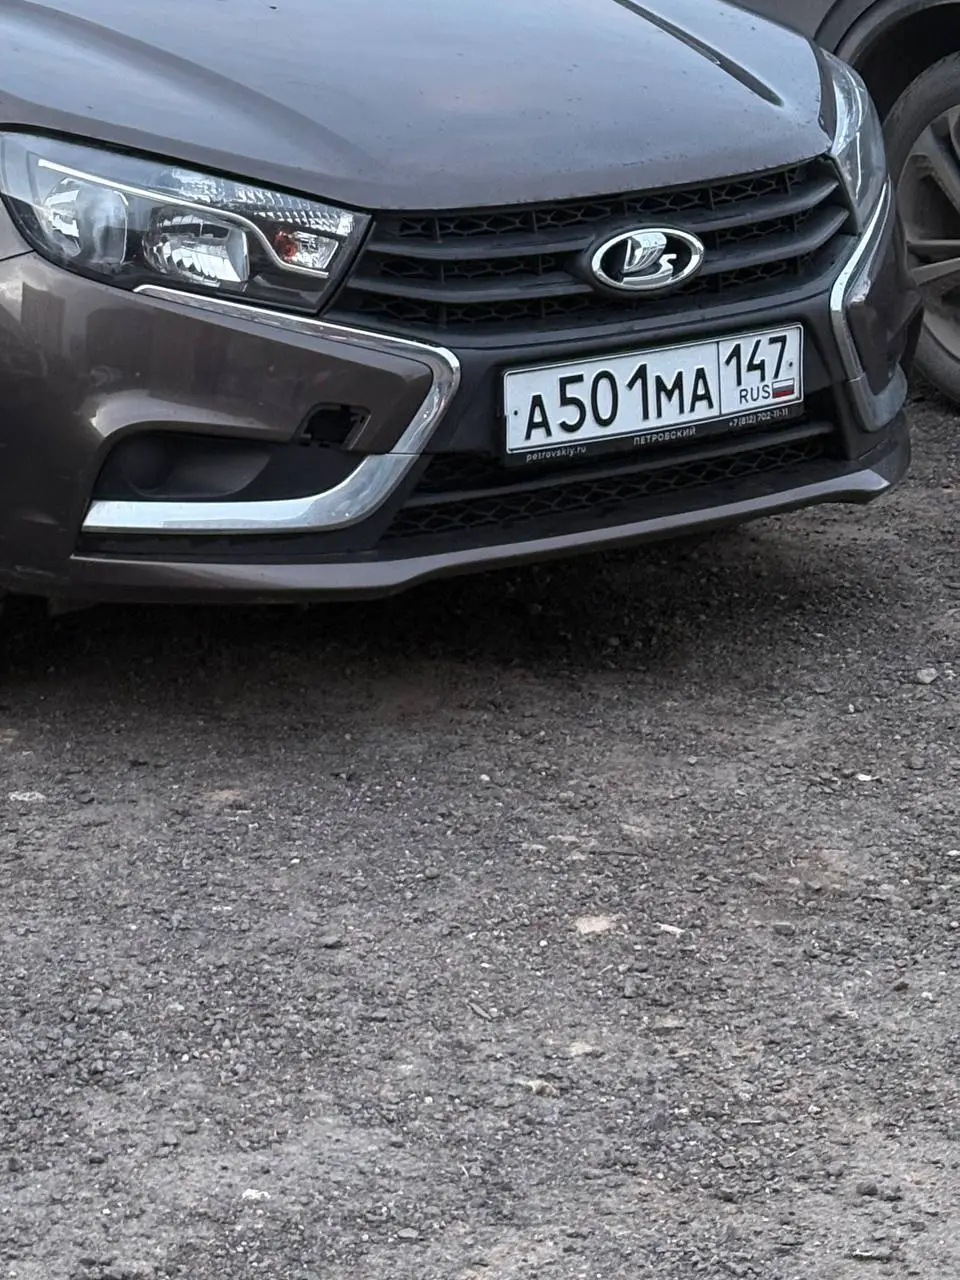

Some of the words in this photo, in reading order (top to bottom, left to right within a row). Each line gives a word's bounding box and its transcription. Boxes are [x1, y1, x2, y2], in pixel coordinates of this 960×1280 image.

[724, 334, 788, 387] 147
[739, 385, 771, 404] RUS
[633, 427, 697, 446] ПЕТРОВСКИЙ
[526, 446, 587, 462] petrovskiy.ru
